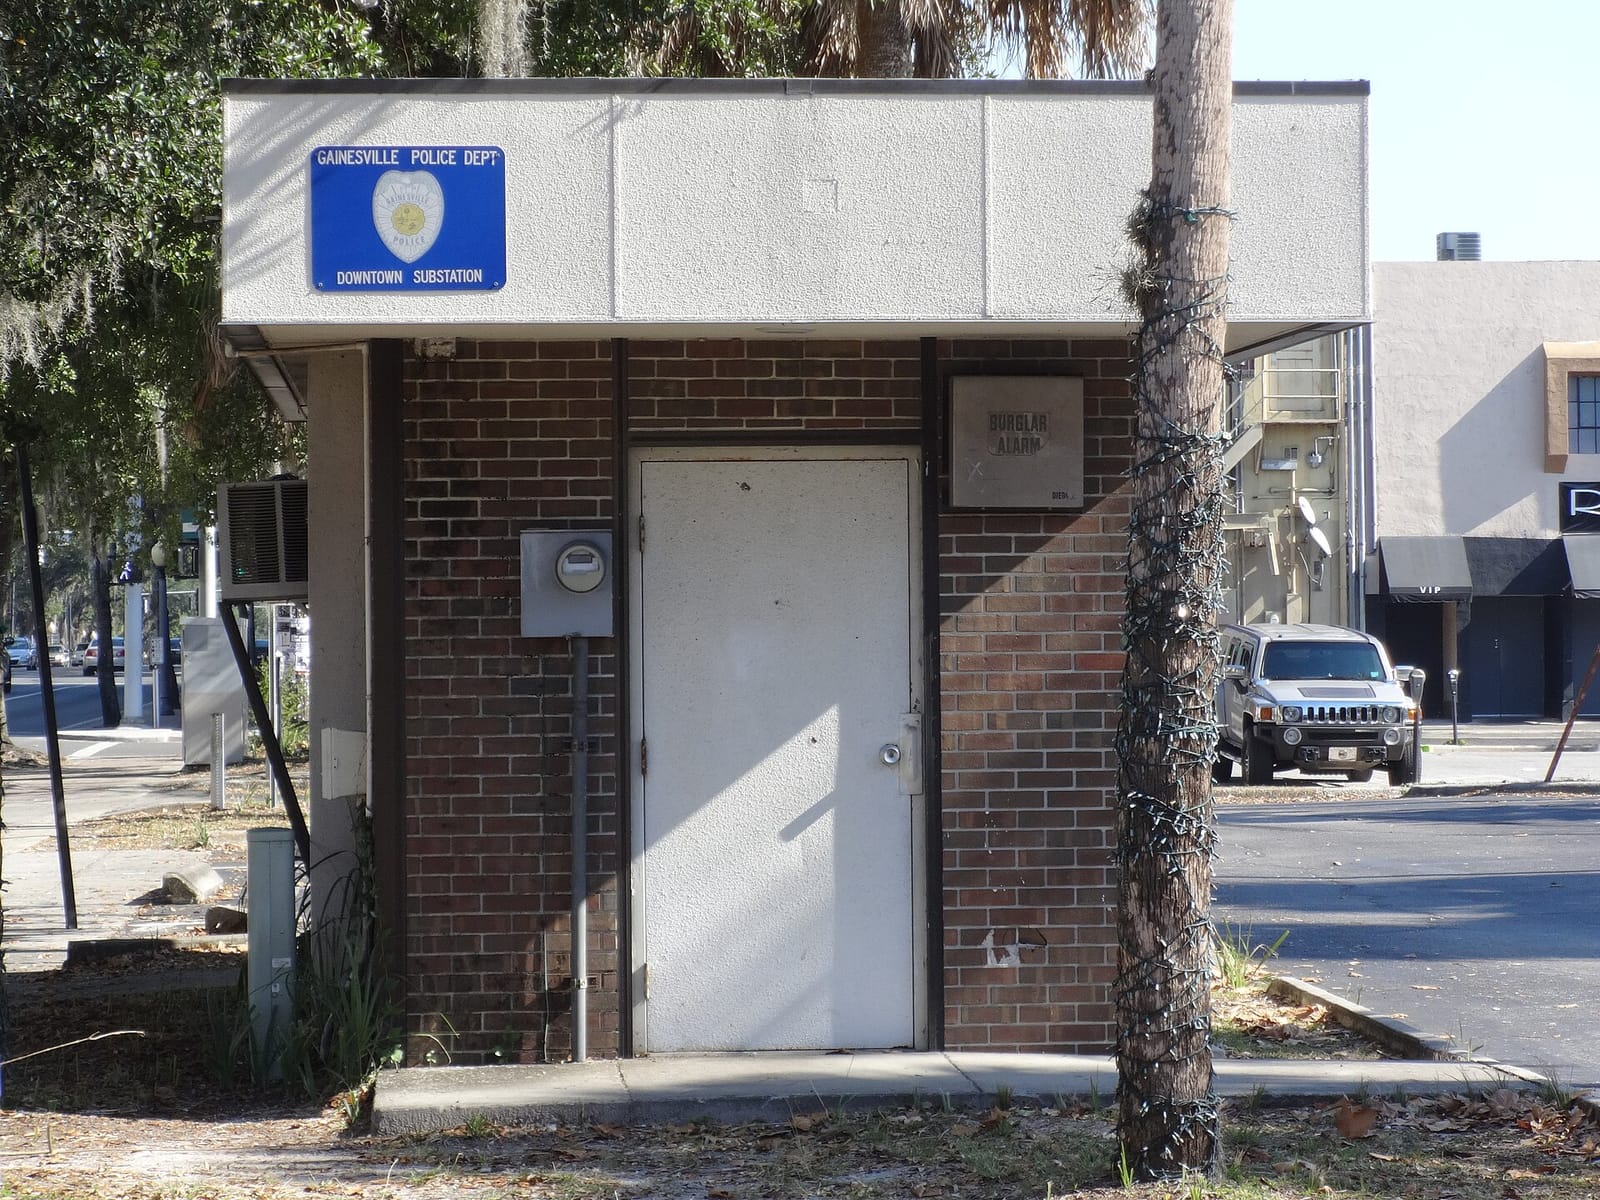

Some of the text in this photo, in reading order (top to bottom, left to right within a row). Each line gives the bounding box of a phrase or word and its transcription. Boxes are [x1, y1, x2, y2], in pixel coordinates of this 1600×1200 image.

[317, 150, 498, 166] GAINESVILLE POLICE DEPT
[393, 235, 425, 246] POLICE
[337, 269, 482, 285] DOWNTOWN SUBSTATION
[989, 414, 1047, 432] BURGLAR
[998, 437, 1041, 454] ALARM
[1419, 586, 1441, 594] VIP
